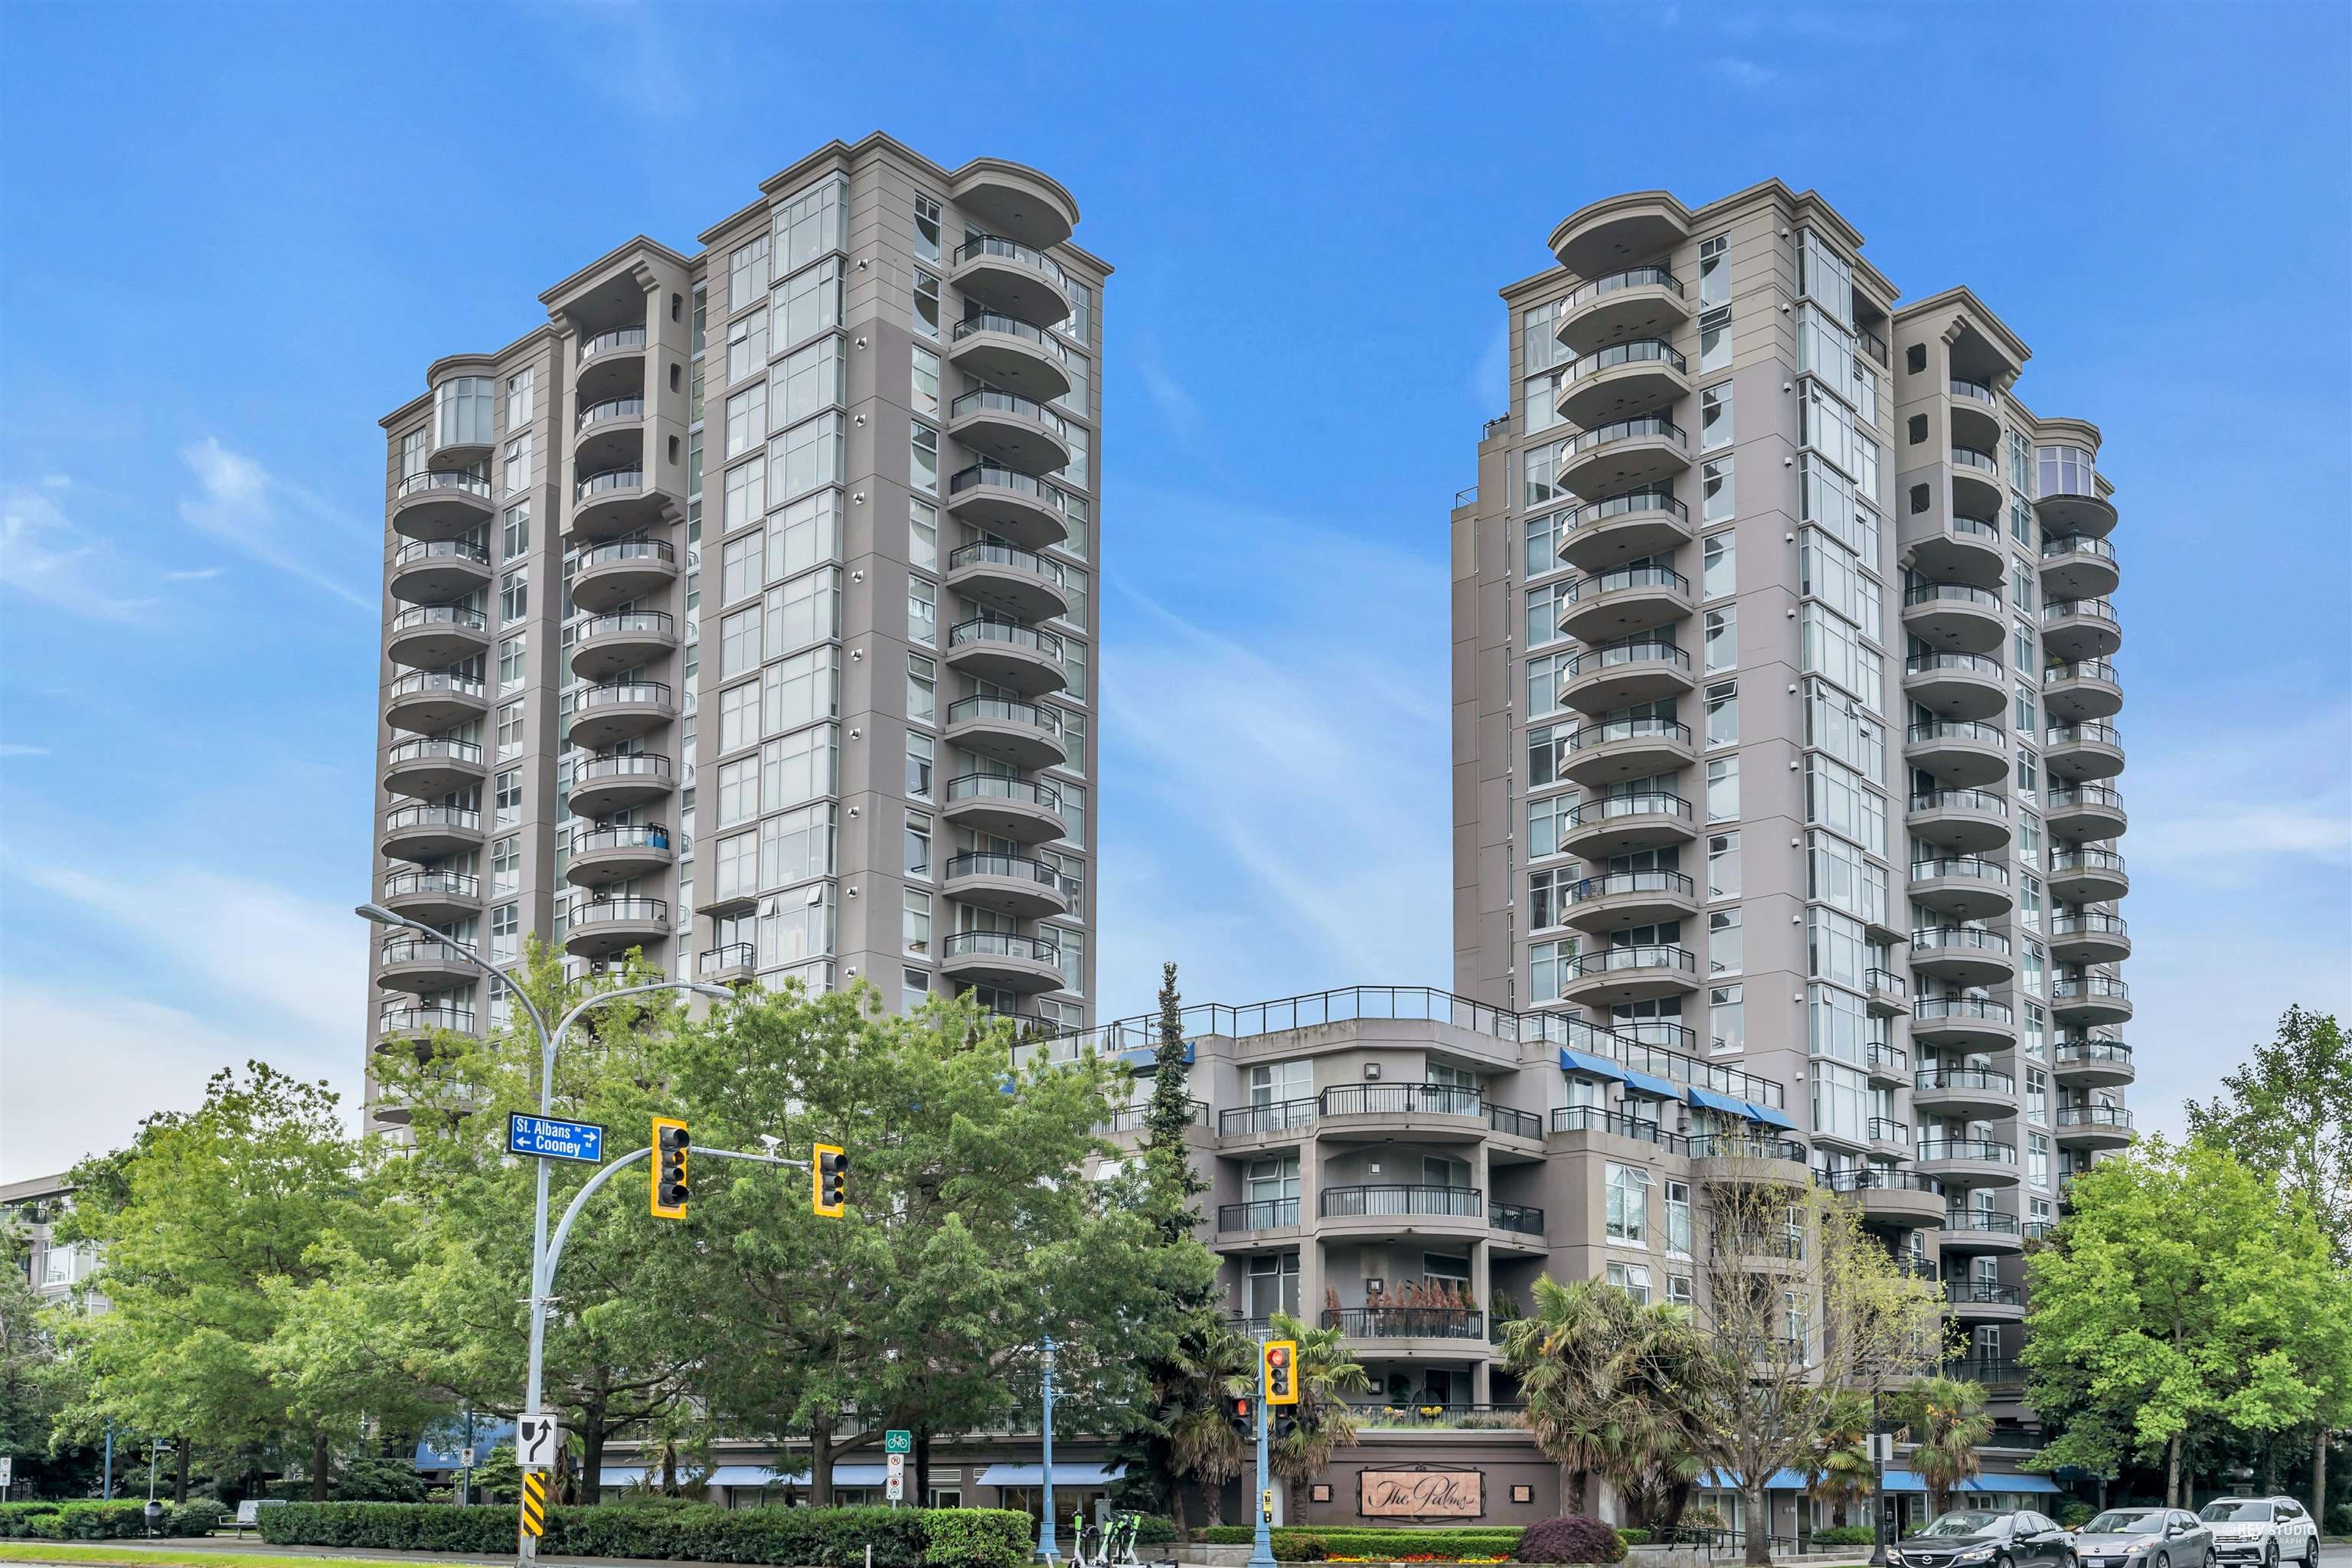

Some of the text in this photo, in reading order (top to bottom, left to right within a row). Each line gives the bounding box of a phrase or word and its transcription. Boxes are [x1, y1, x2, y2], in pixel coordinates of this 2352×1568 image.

[516, 1118, 531, 1133] St.
[534, 1120, 571, 1139] Albans
[536, 1135, 581, 1157] Cooney
[1368, 1475, 1475, 1513] The Palms
